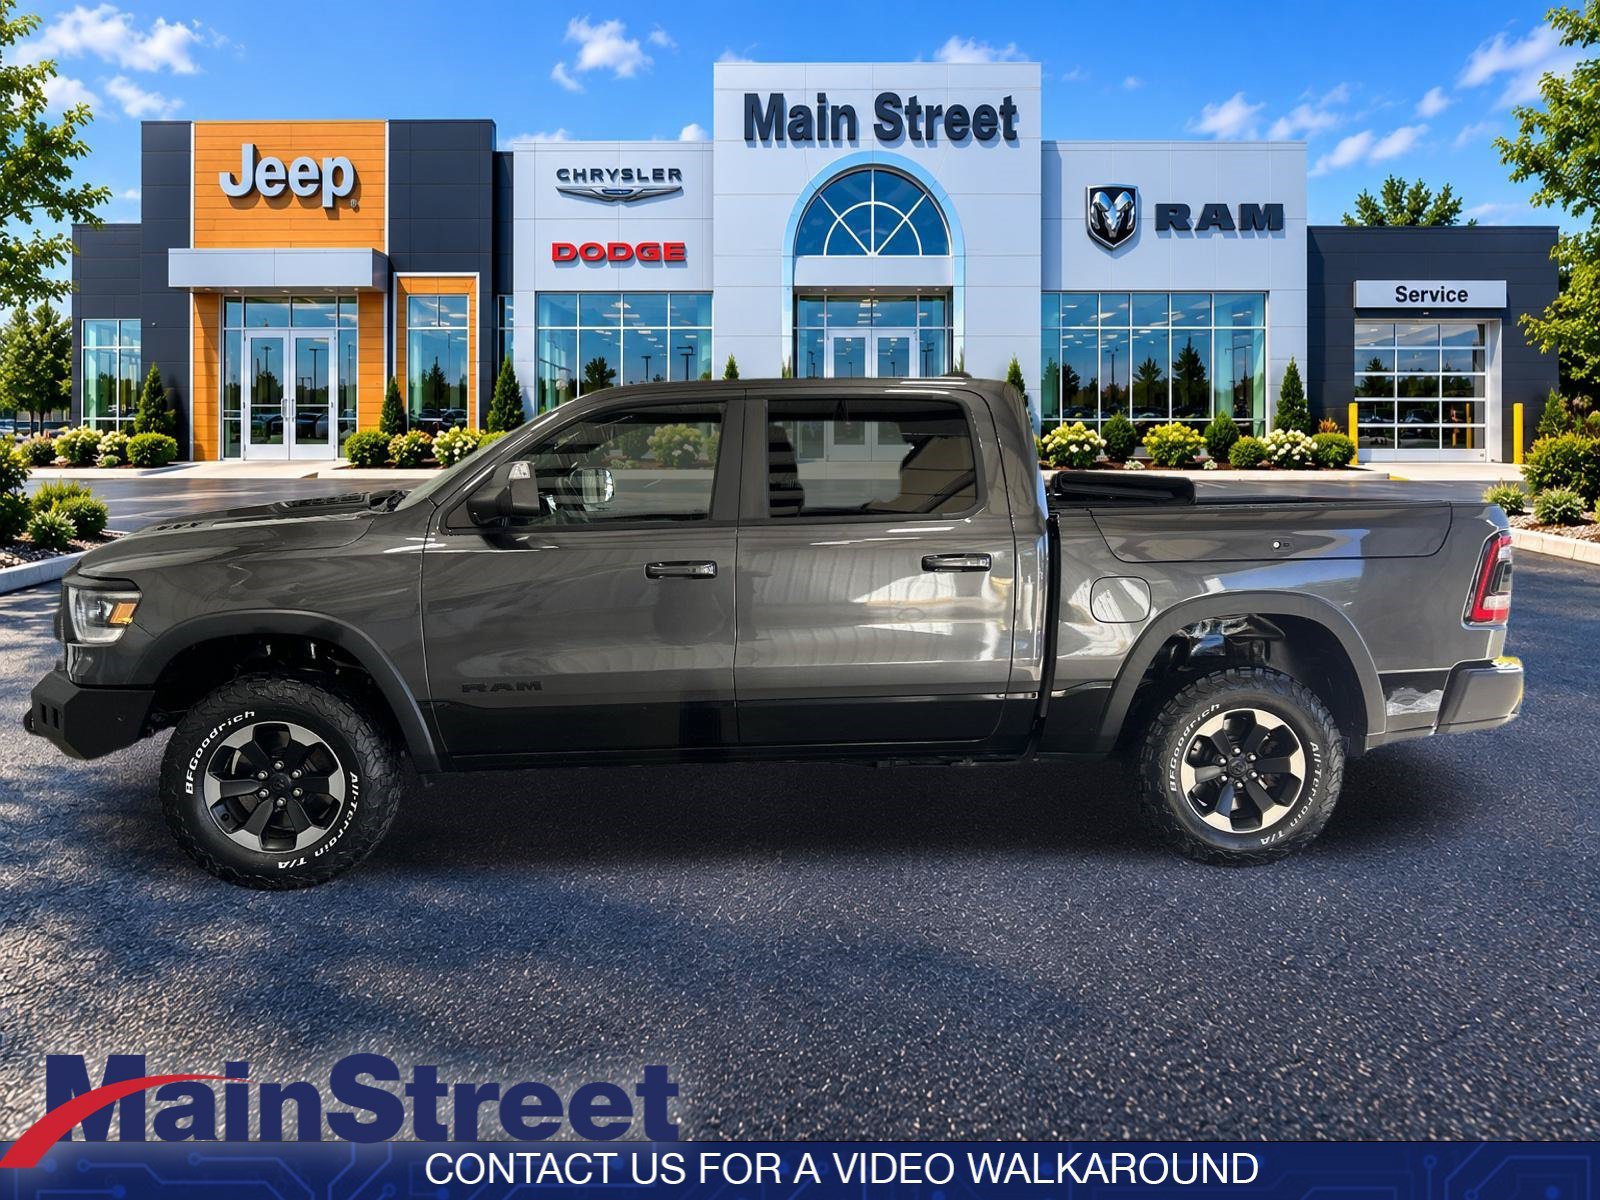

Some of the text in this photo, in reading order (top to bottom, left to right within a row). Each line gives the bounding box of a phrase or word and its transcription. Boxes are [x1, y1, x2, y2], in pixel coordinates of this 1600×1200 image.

[743, 92, 1019, 143] Main Street
[219, 143, 355, 209] Jeep
[556, 166, 682, 184] CHRYSLER
[1154, 202, 1284, 232] RAM
[551, 242, 687, 263] DODGE
[1394, 284, 1469, 305] Service
[461, 681, 543, 693] RAM
[185, 711, 255, 795] BFGoodrich
[1170, 703, 1220, 792] BFGoodrich
[1260, 830, 1286, 846] T/A
[277, 860, 307, 869] T/A
